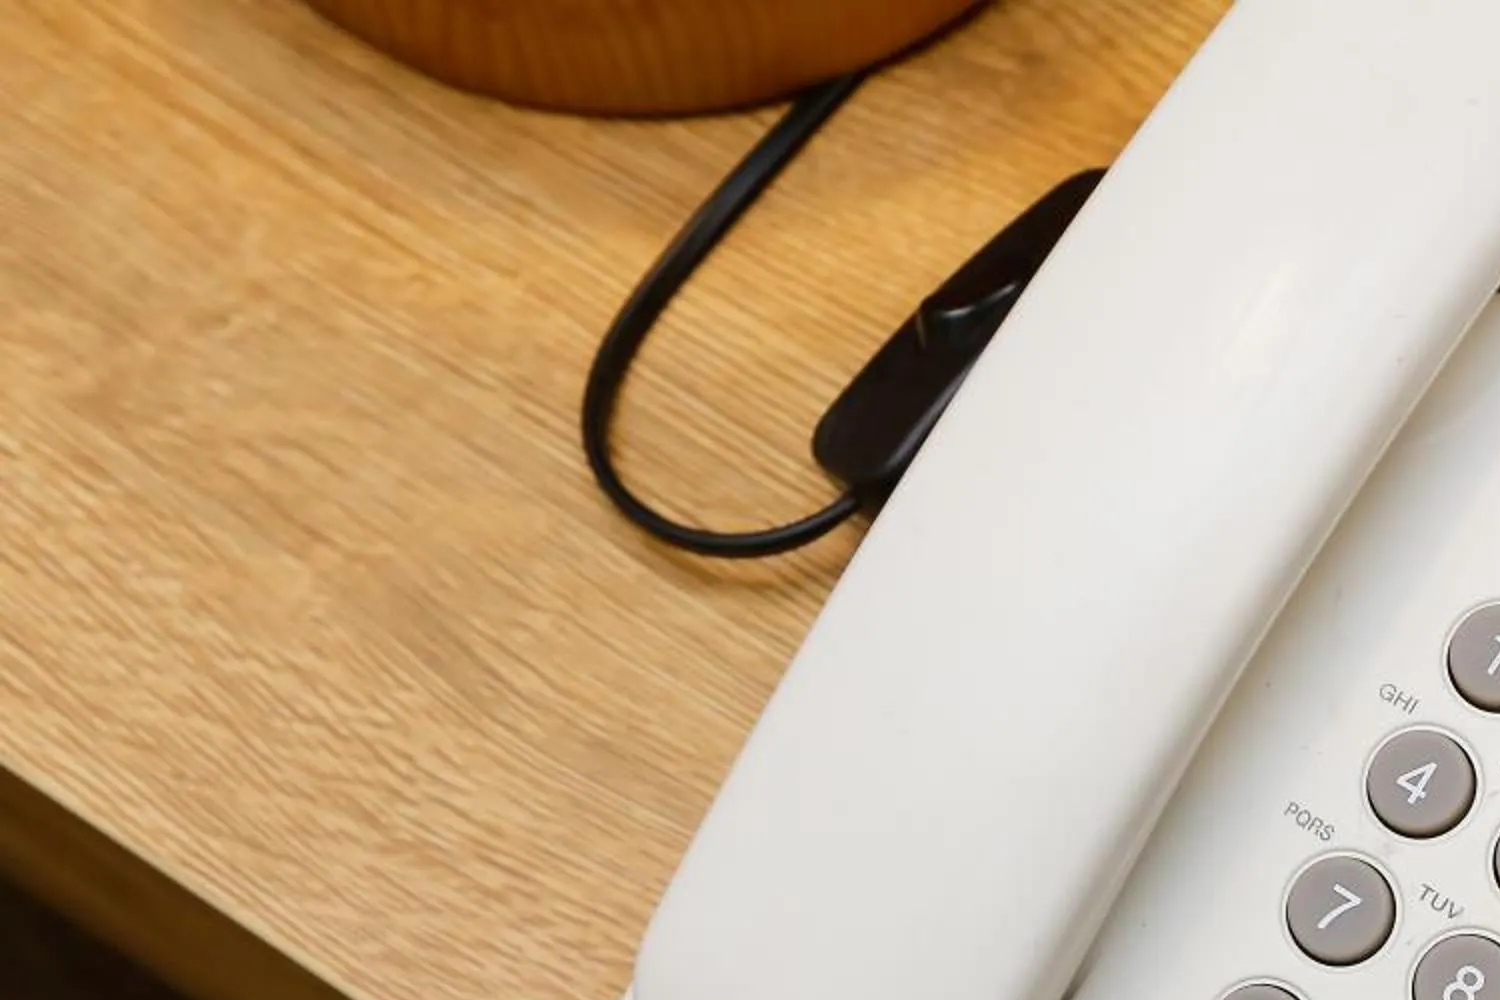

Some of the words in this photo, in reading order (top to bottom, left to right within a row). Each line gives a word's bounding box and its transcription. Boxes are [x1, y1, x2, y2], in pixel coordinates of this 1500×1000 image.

[1378, 683, 1420, 714] GHI
[1397, 761, 1439, 804] 4
[1283, 801, 1336, 843] PQRS
[1317, 883, 1363, 930] 7
[1418, 884, 1465, 920] TUV
